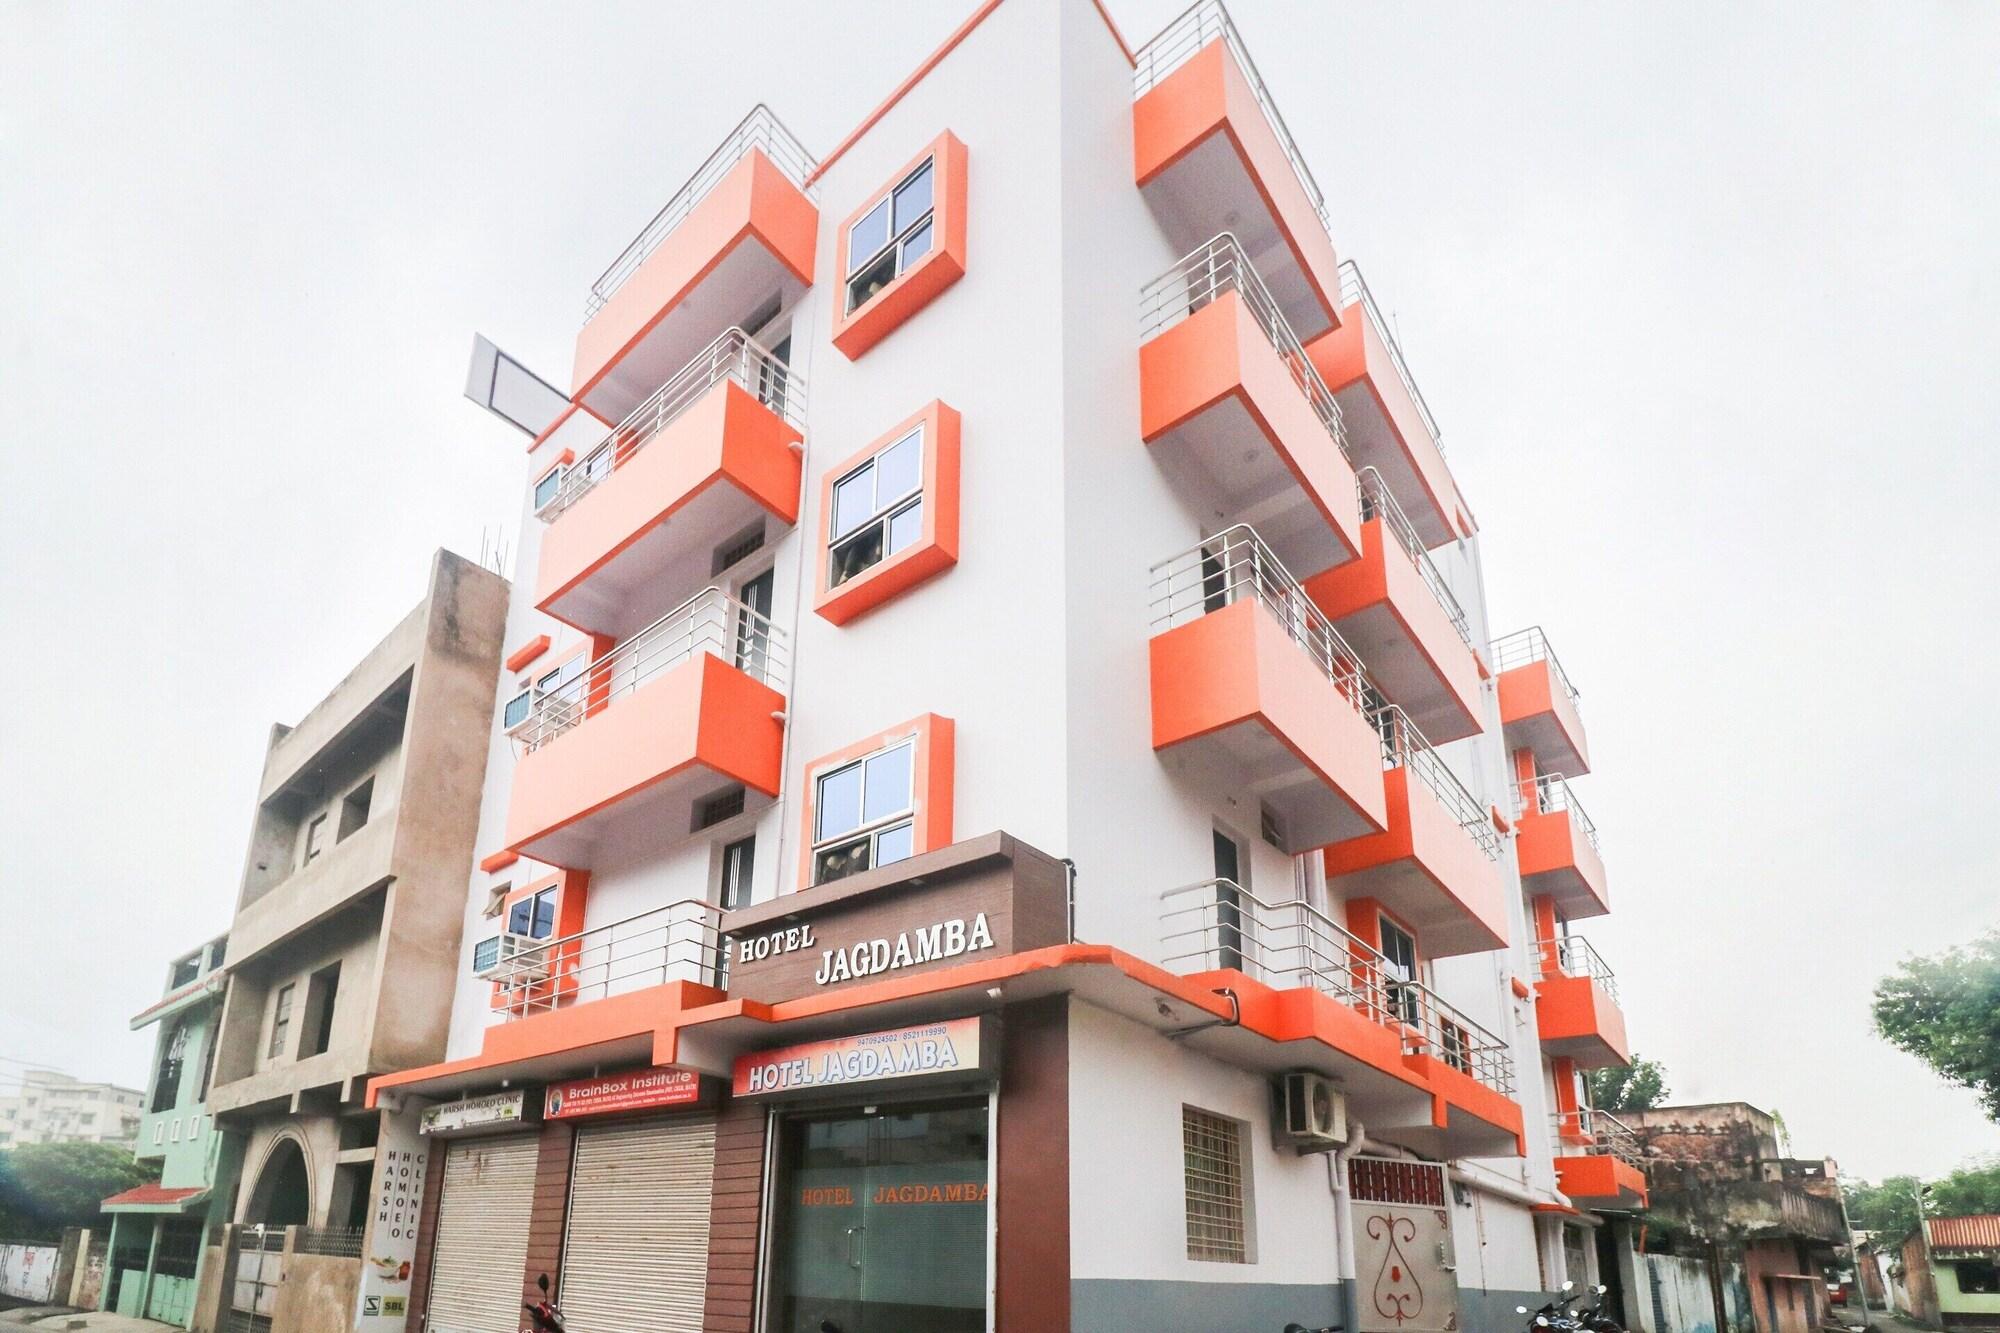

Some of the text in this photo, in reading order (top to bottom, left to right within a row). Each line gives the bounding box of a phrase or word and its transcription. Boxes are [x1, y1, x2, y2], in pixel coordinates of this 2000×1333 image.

[739, 924, 815, 963] HOTEL
[815, 912, 995, 985] JAGDAMBA
[569, 1081, 628, 1099] BrainBox
[632, 1071, 692, 1090] Institute
[749, 1035, 959, 1093] HOTEL JAGDAMBA
[443, 1104, 465, 1114] HARSH
[497, 1095, 521, 1106] CLINIC
[379, 1151, 396, 1222] HARSH
[391, 1152, 410, 1238] HOMOEO
[406, 1154, 425, 1240] CLINIC
[801, 1183, 988, 1206] HOTEL JAGDAMBA
[384, 1300, 404, 1312] SBL
